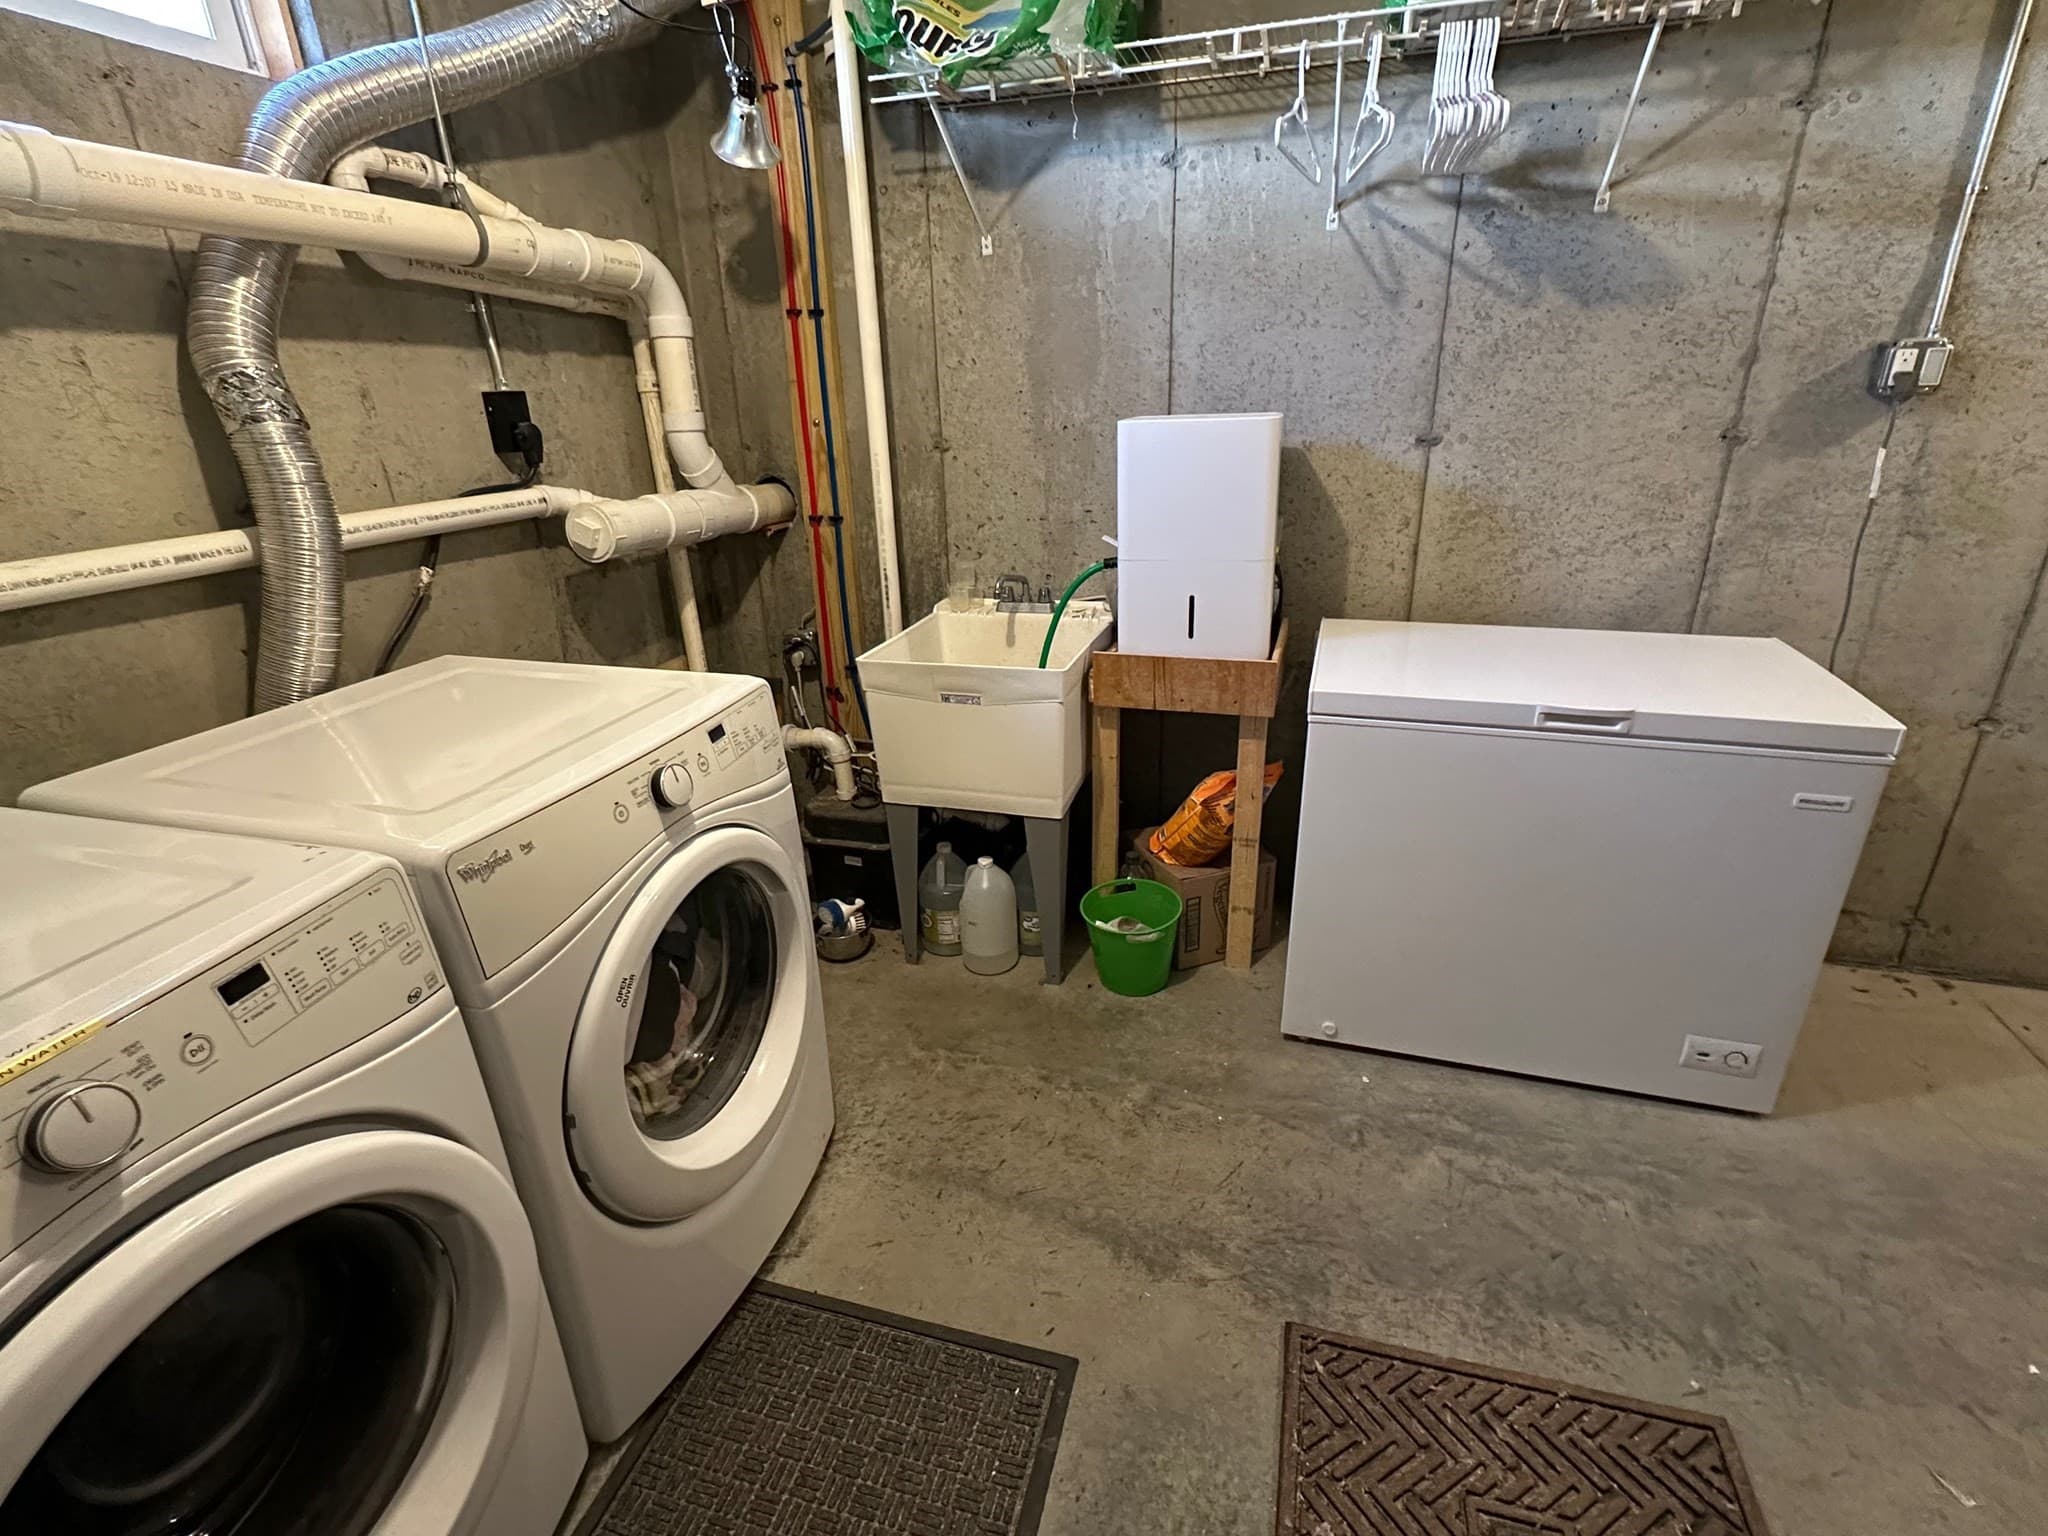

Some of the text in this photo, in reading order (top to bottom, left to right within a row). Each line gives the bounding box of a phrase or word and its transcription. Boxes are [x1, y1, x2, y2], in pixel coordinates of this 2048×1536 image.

[182, 183, 207, 197] MADE
[210, 186, 223, 198] IN
[329, 205, 341, 217] TO
[448, 266, 486, 281] NAPCO
[456, 849, 513, 883] Whirlpool
[615, 977, 628, 1003] OPEN
[621, 974, 637, 1008] OUVRIR
[18, 1028, 88, 1068] WATER
